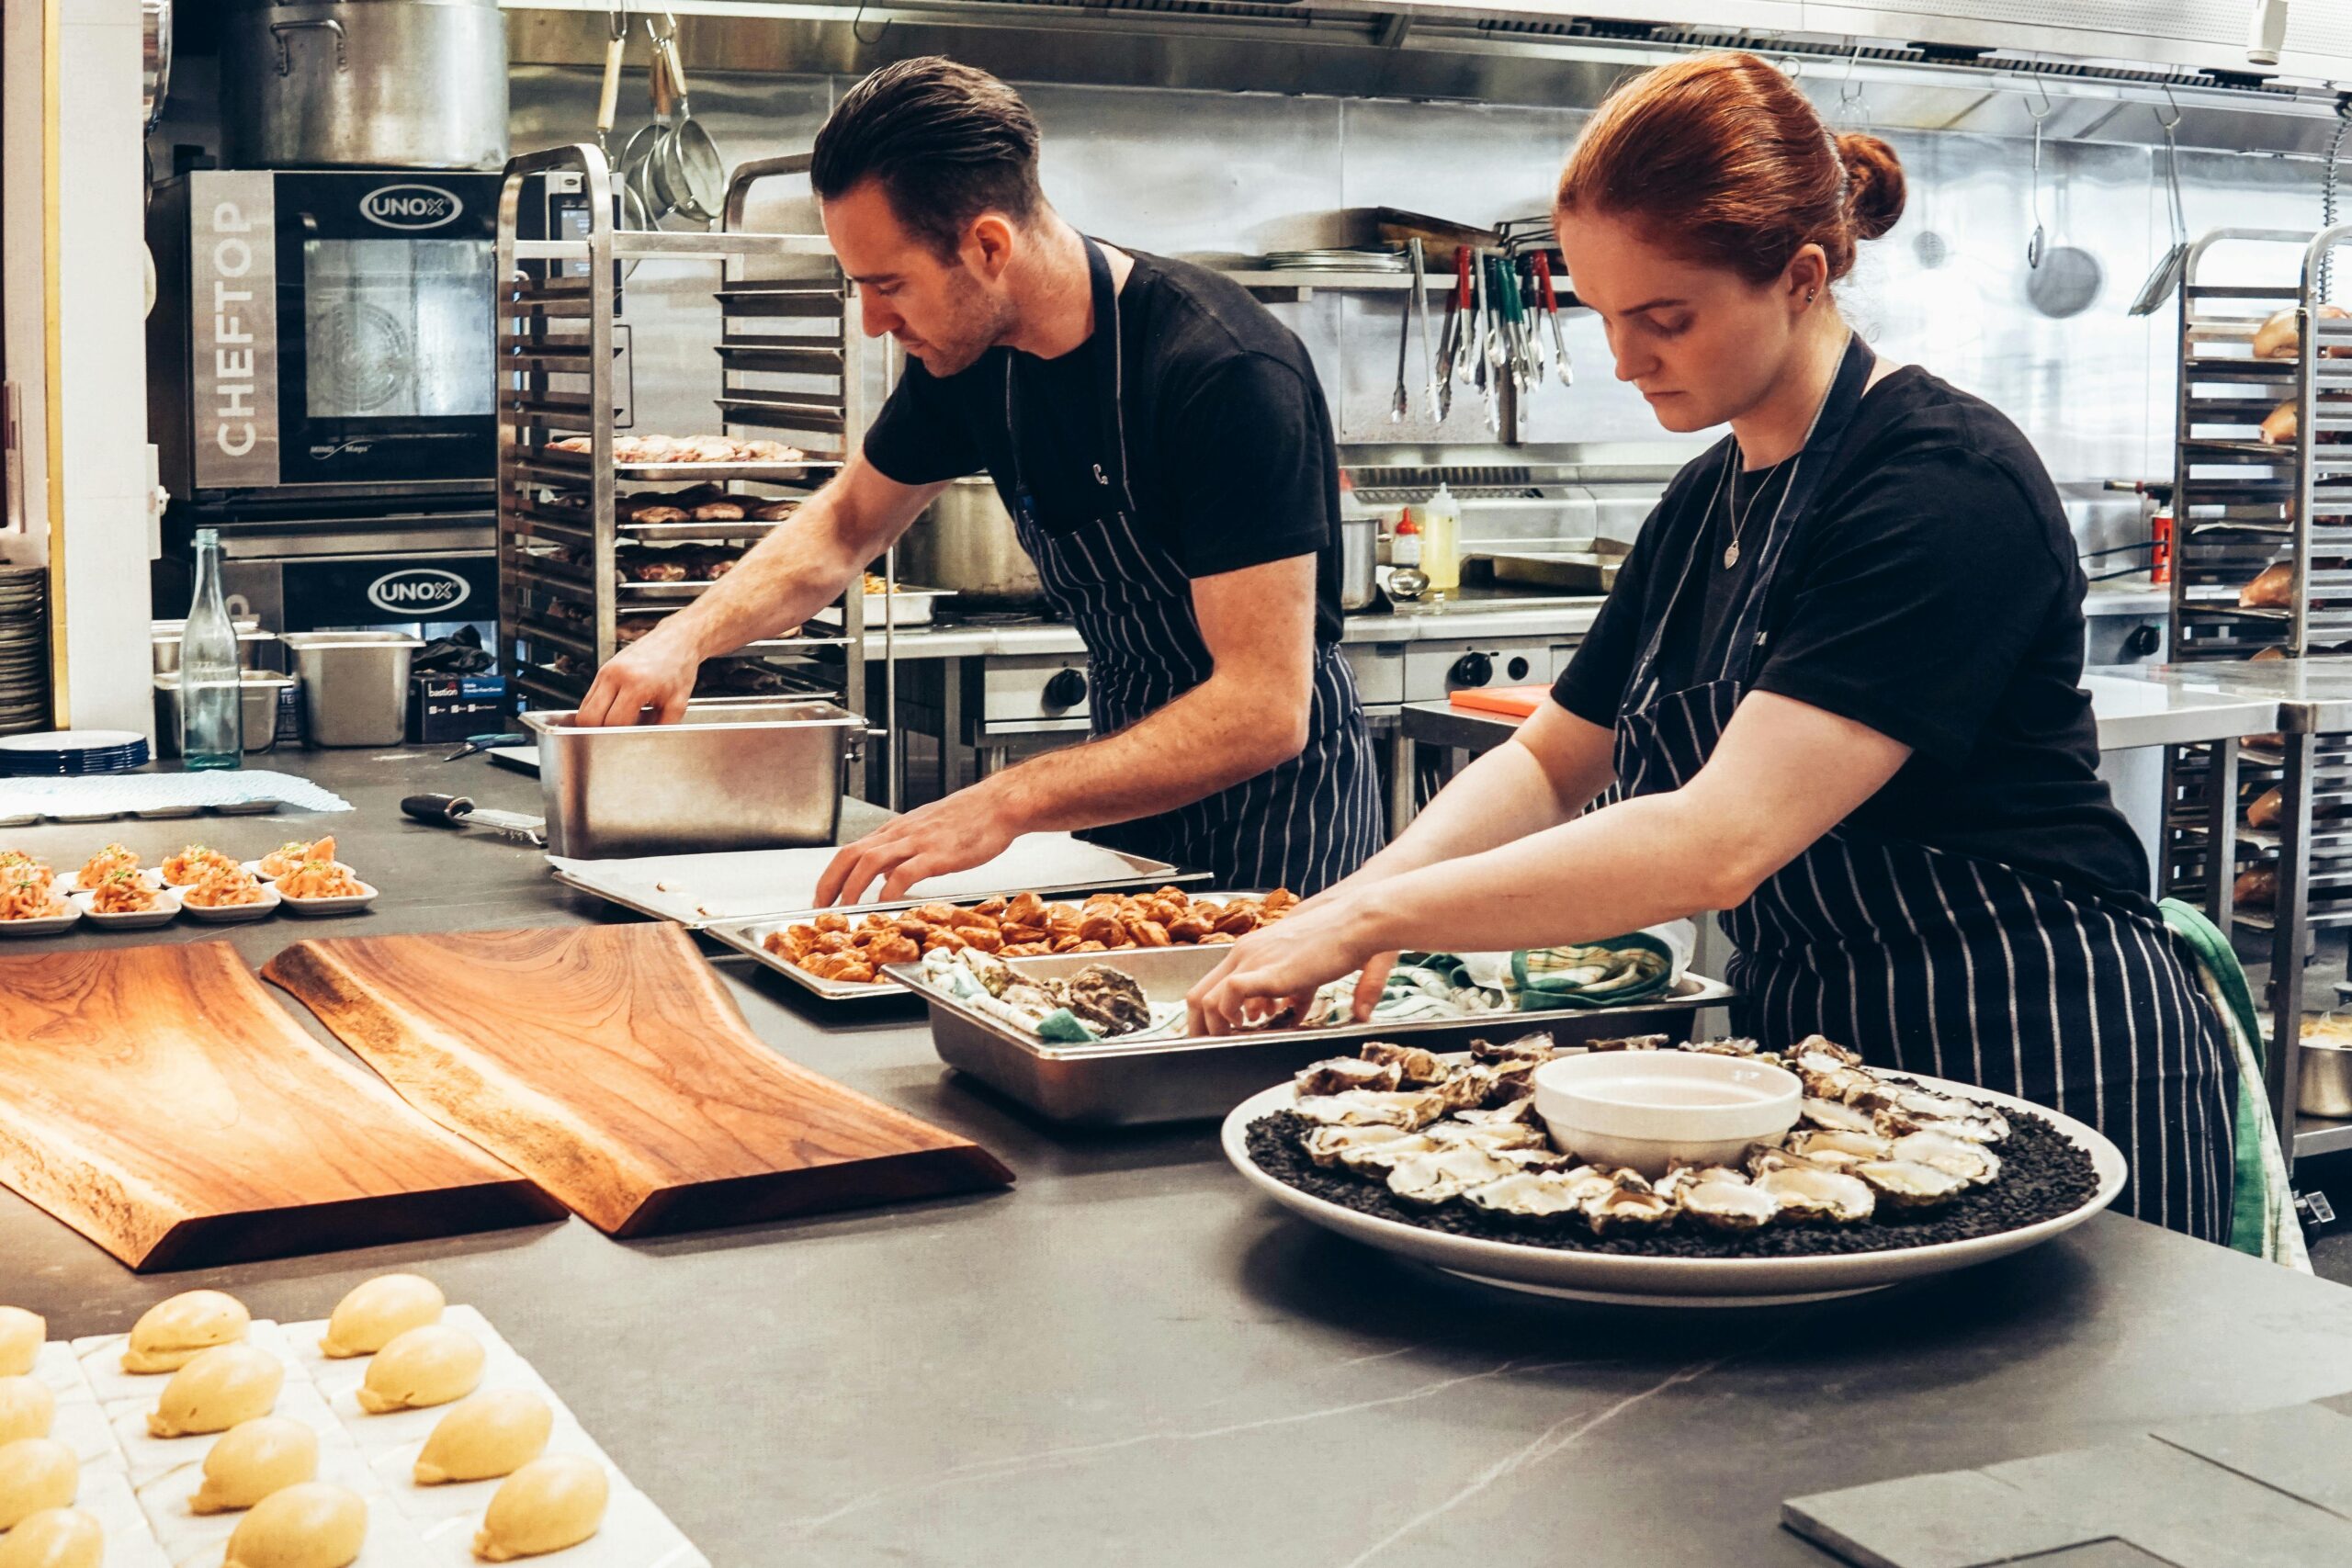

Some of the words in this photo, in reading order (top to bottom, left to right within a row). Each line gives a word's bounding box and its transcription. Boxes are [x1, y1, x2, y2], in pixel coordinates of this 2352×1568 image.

[372, 197, 446, 216] UNOX
[214, 202, 255, 457] CHEFTOP
[380, 581, 453, 602] UNOX
